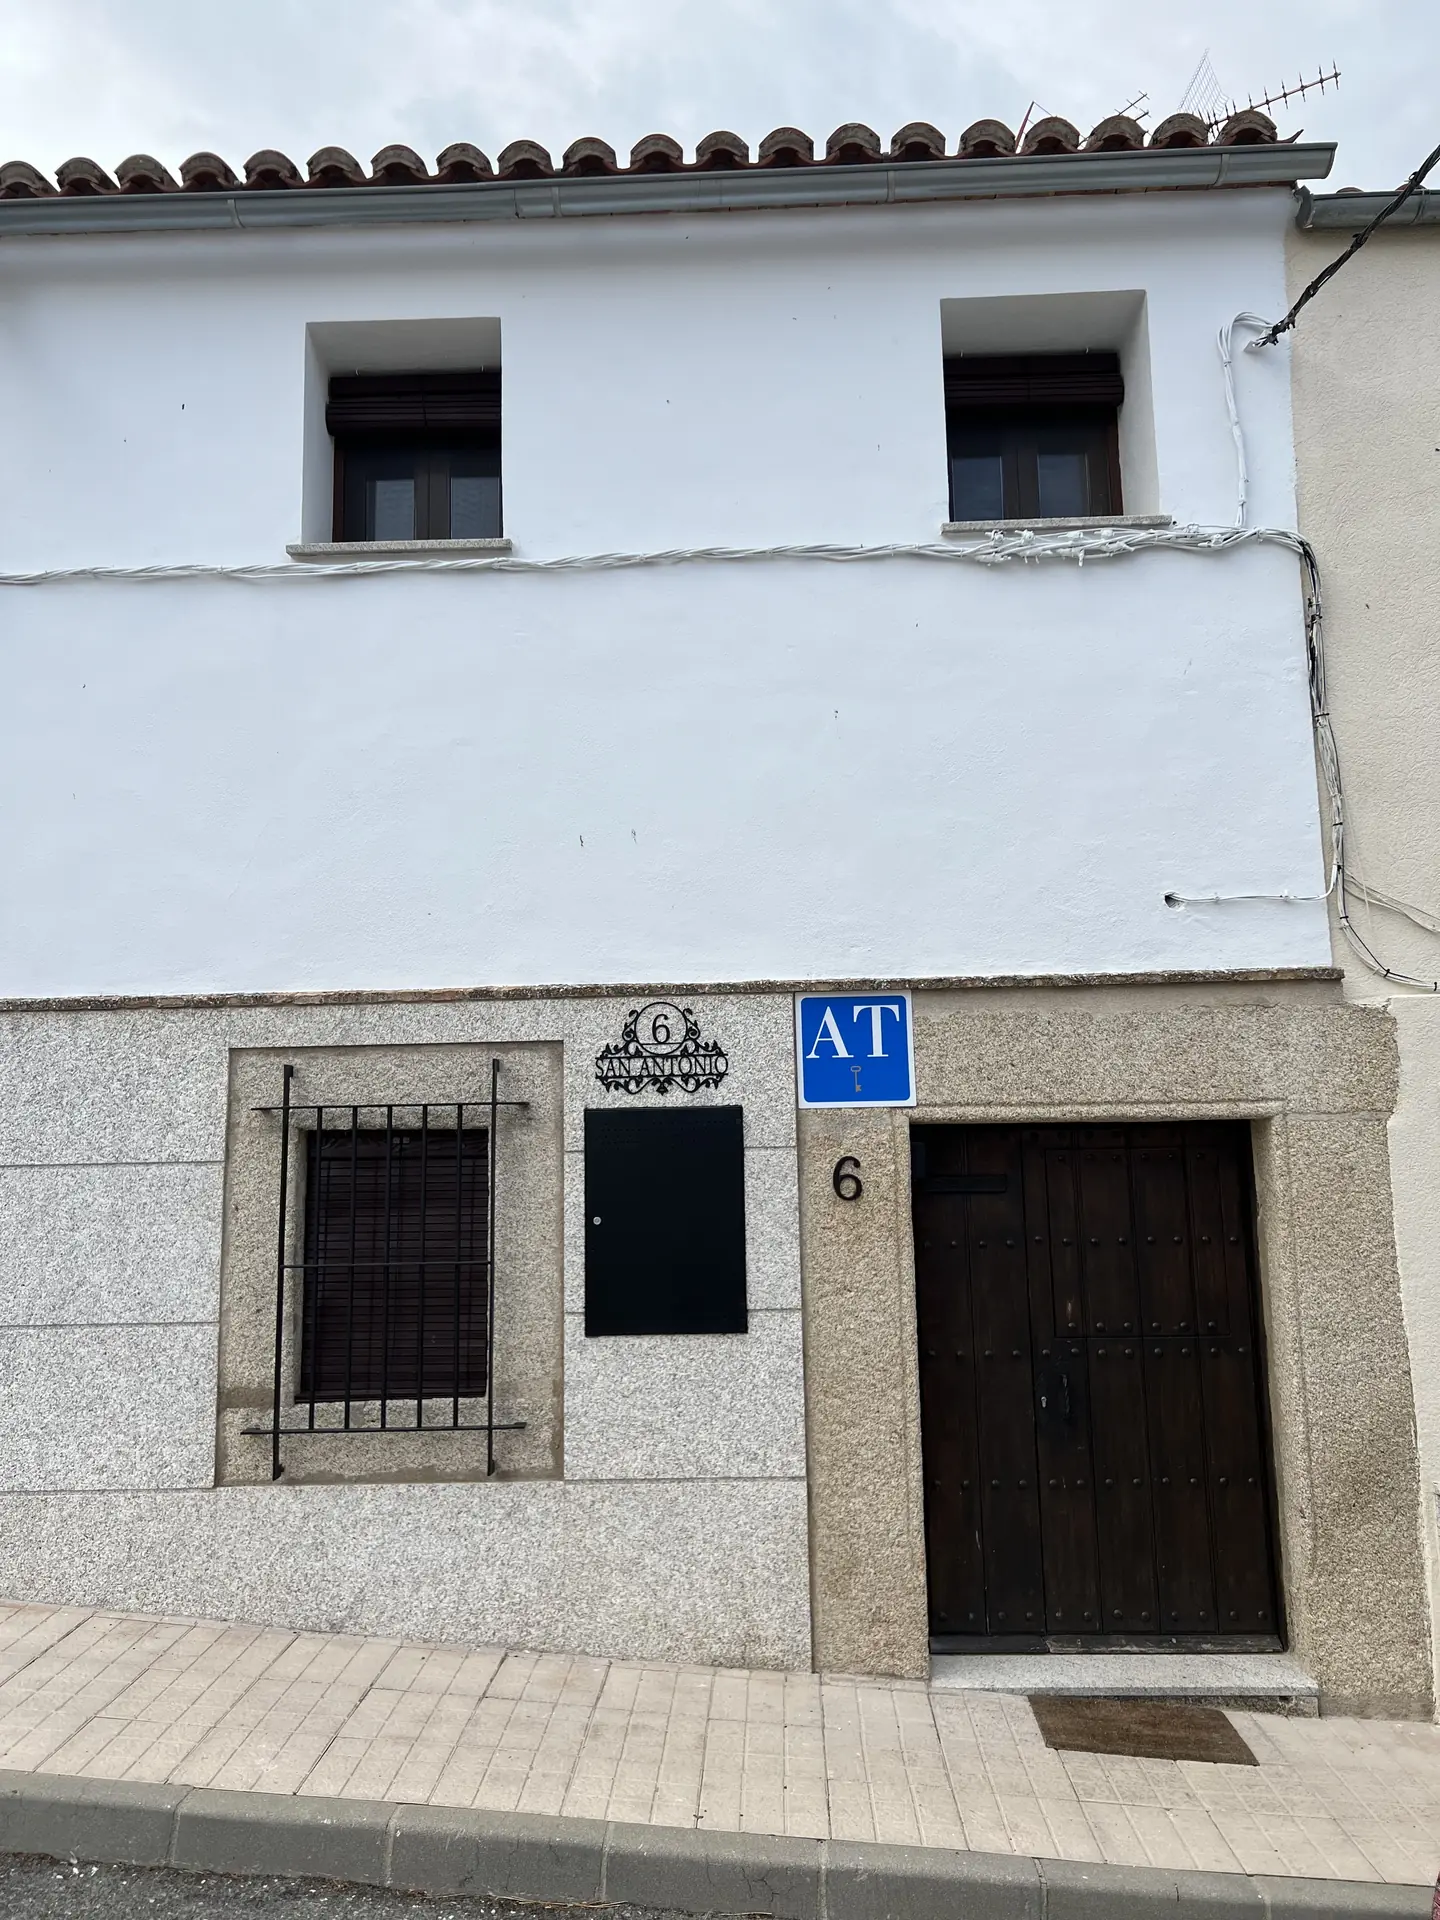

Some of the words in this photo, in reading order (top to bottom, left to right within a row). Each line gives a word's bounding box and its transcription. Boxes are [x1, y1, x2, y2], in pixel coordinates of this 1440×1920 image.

[652, 1013, 670, 1044] 6
[806, 1004, 900, 1059] AT
[595, 1056, 631, 1078] SAN
[640, 1054, 729, 1077] ANTONIO
[833, 1156, 863, 1201] 6
